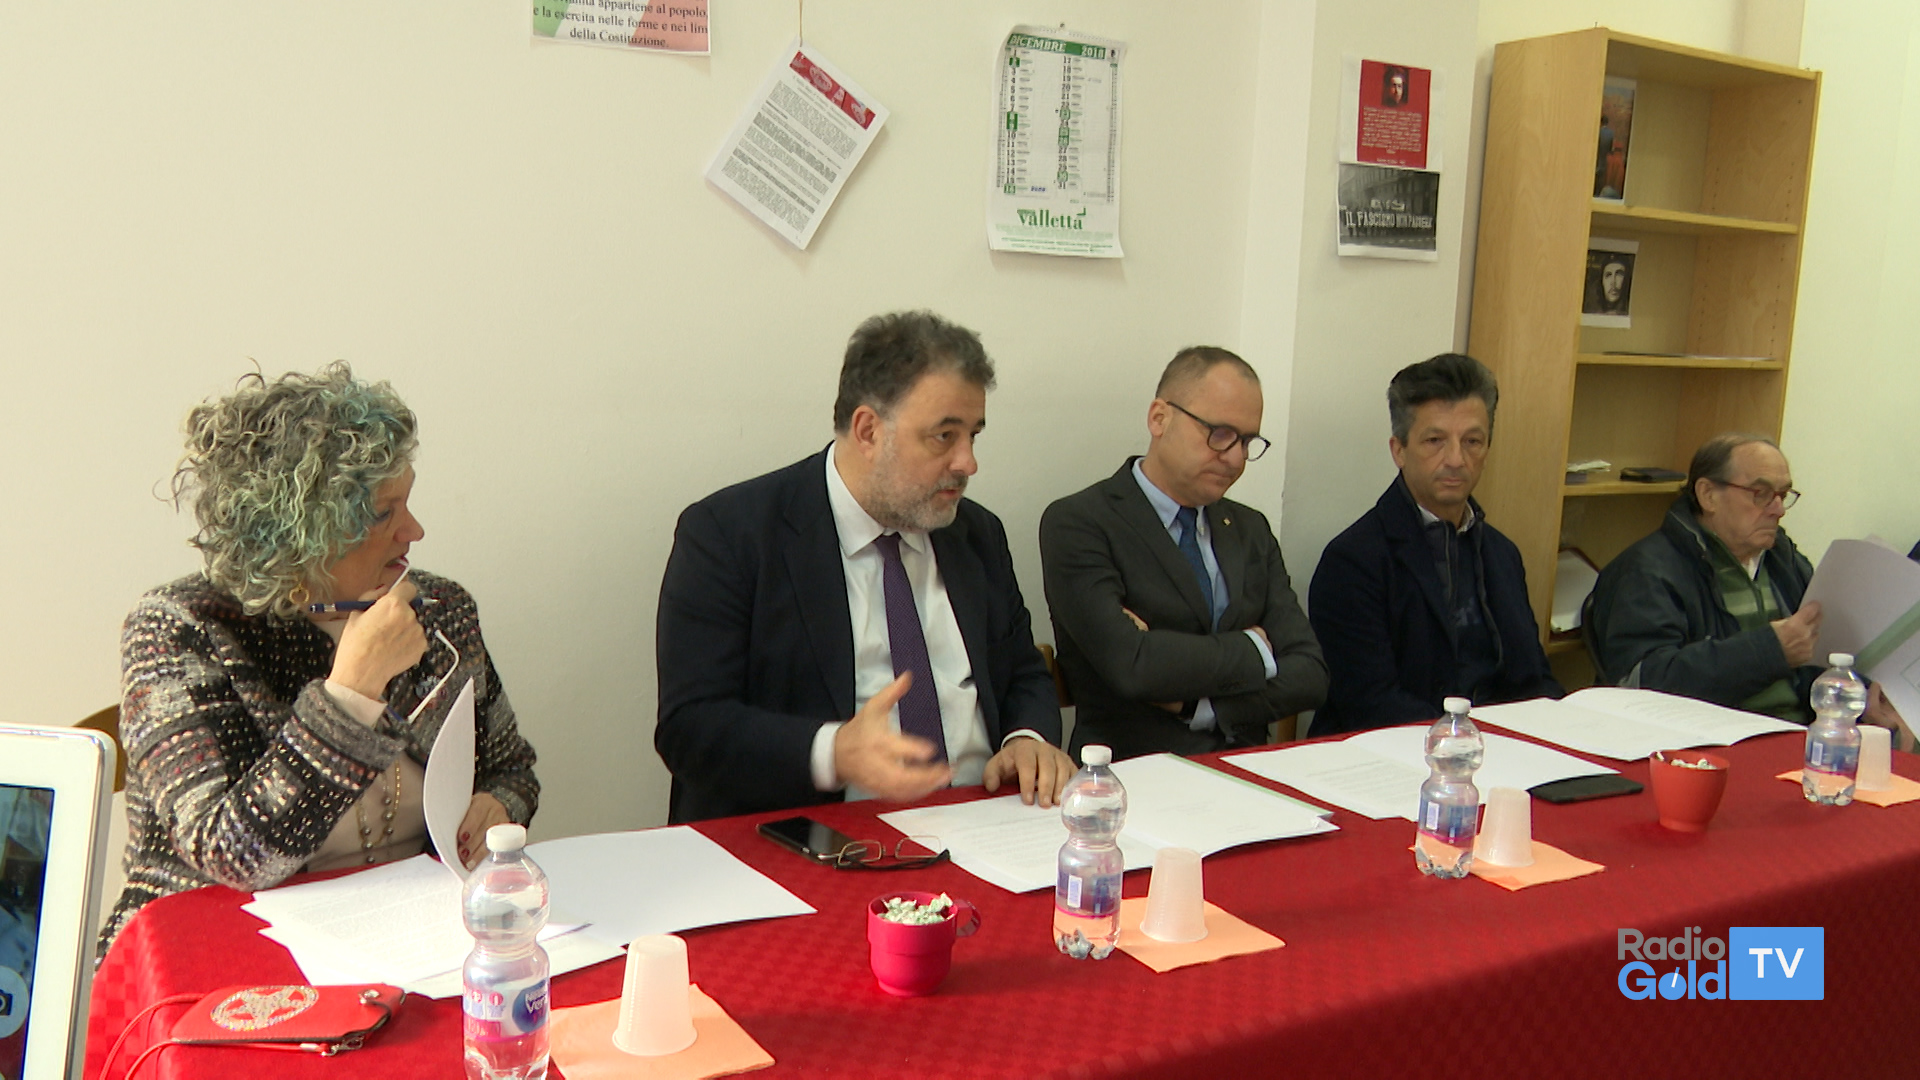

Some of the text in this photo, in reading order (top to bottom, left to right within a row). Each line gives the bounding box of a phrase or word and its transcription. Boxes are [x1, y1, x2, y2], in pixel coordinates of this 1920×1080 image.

[598, 1, 652, 12] appartiene
[656, 4, 666, 13] al
[542, 7, 551, 17] la
[554, 11, 595, 23] esercita
[598, 14, 624, 26] nelle
[627, 16, 658, 30] forme
[661, 23, 668, 31] e
[670, 22, 687, 32] nei
[569, 28, 670, 48] della Costituzione.
[1010, 35, 1066, 52] DICEMBRE
[1017, 209, 1082, 230] Valletta
[1345, 211, 1356, 227] IL
[1357, 211, 1395, 228] FASCISMO
